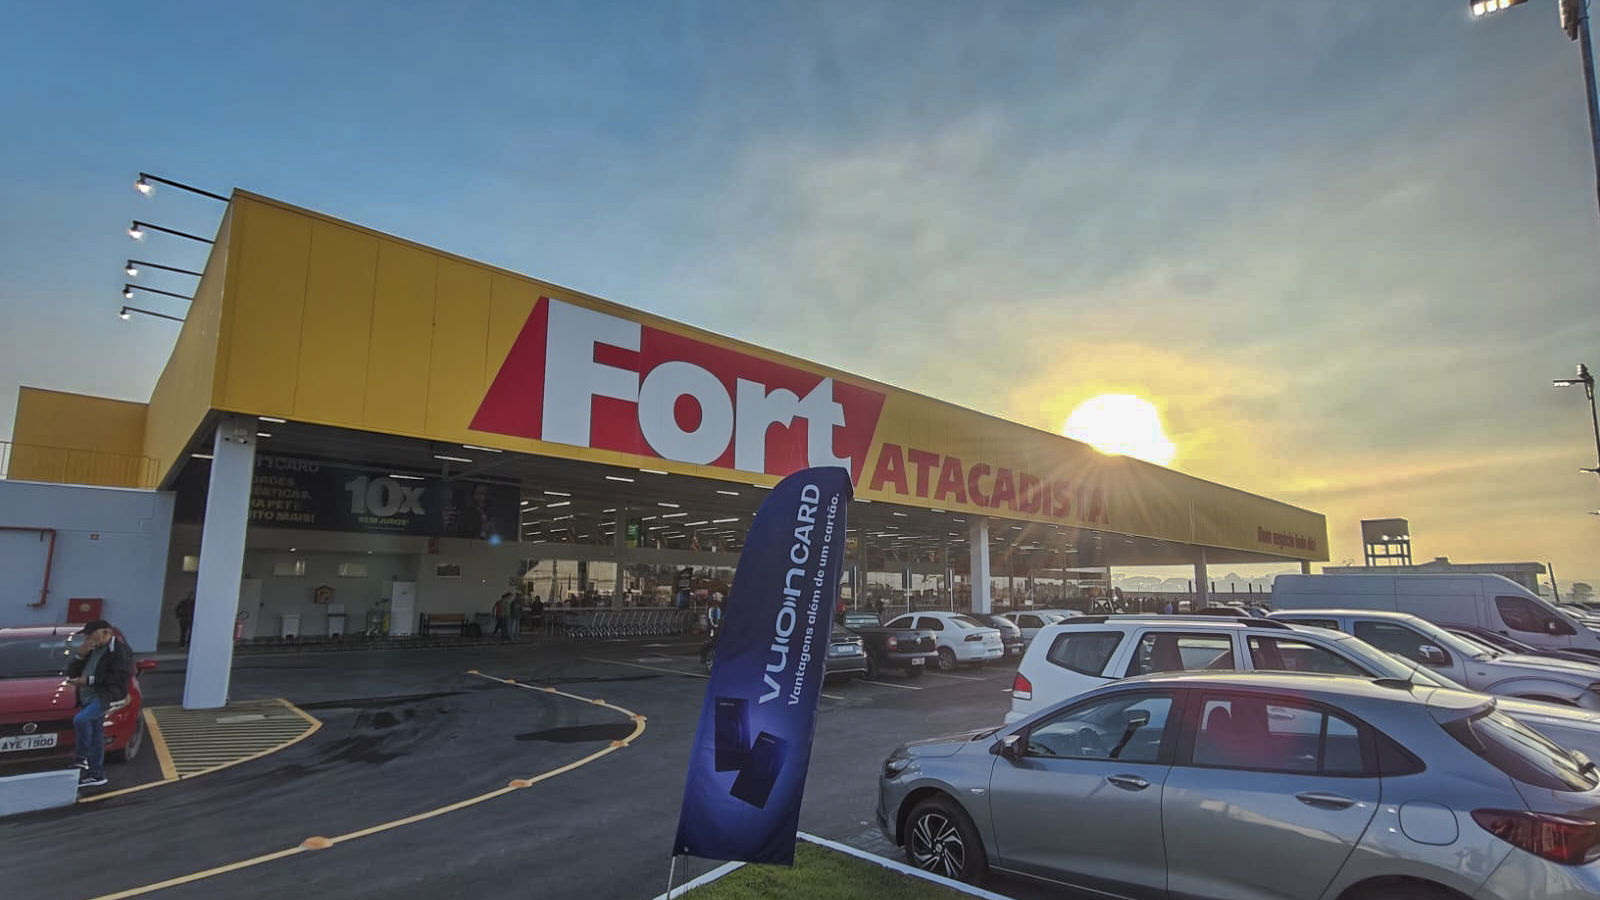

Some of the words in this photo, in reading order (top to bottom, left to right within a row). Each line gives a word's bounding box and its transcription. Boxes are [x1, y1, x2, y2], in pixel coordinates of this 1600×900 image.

[541, 298, 852, 486] Fort
[345, 475, 426, 517] 10x
[869, 443, 1110, 525] ATACADISTA
[824, 493, 840, 543] cartão.
[813, 570, 825, 587] de
[820, 545, 830, 567] um
[807, 590, 821, 625] além
[788, 627, 814, 705] Vantagens
